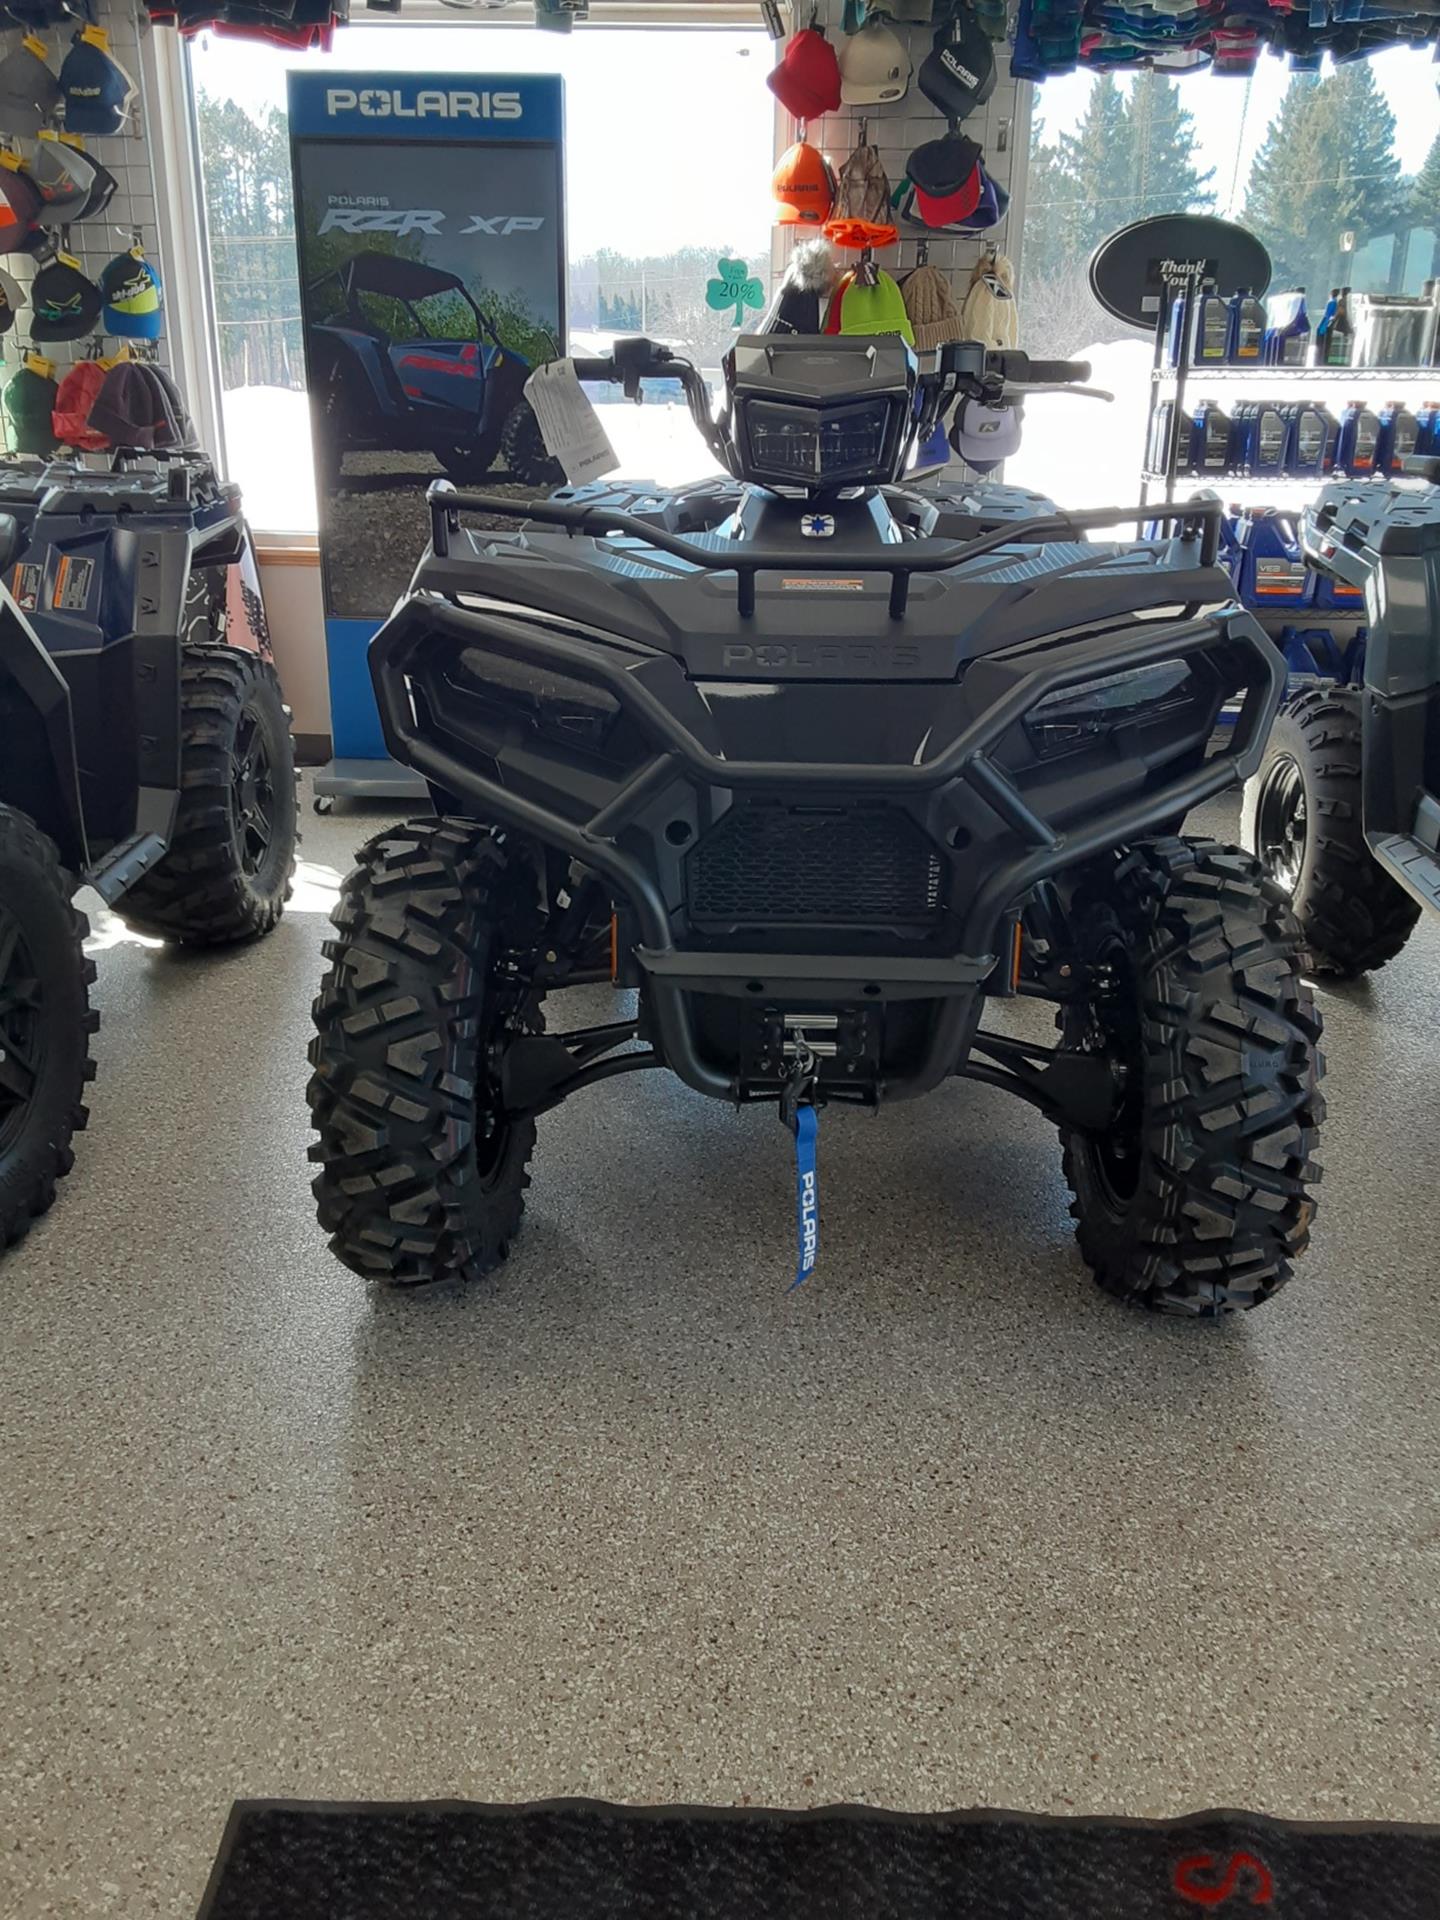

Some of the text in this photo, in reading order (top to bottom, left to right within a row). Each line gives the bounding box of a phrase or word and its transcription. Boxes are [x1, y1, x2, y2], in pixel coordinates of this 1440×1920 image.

[942, 49, 979, 87] POLARIS
[326, 89, 523, 119] POLARIS
[327, 195, 389, 207] POLARIS
[776, 183, 819, 192] POLARIS
[317, 208, 545, 237] RZR XP
[1160, 259, 1205, 273] Thank
[719, 281, 756, 300] 20%
[721, 642, 921, 669] POLARIS
[802, 1171, 817, 1271] POLARIS
